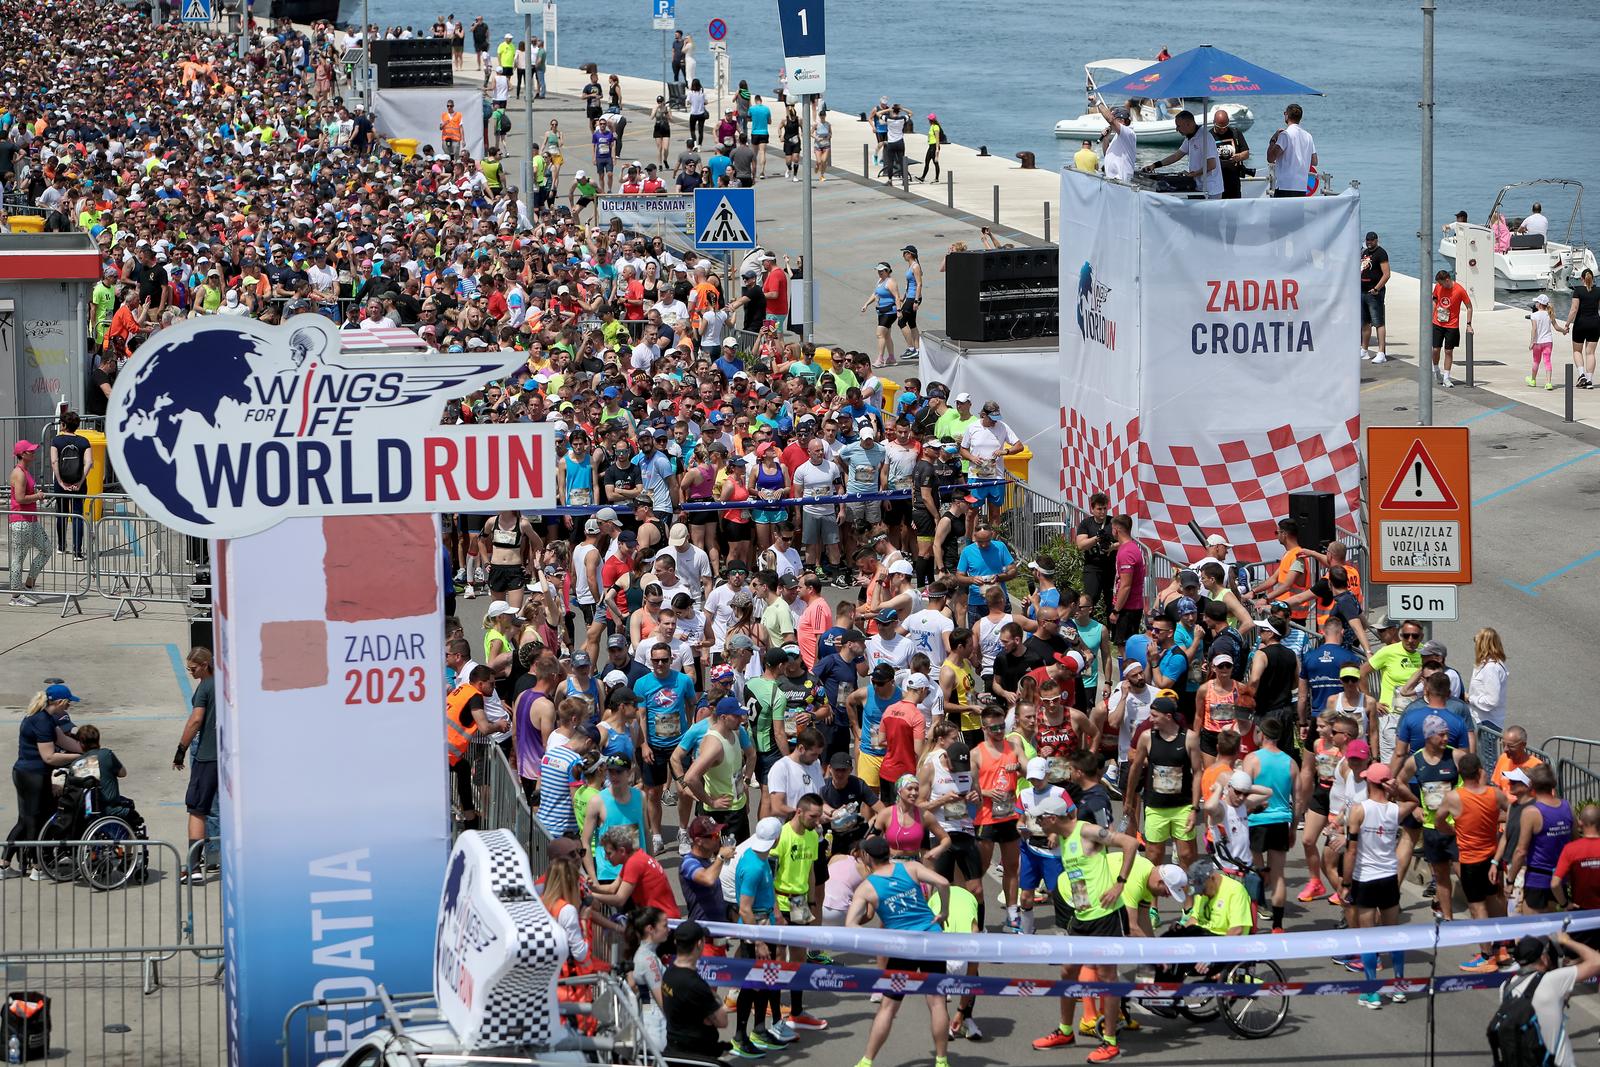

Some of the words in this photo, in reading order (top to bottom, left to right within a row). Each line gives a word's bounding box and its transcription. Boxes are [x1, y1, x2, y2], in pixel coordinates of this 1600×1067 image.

[797, 9, 808, 36] 1
[1209, 84, 1236, 92] Red
[1236, 83, 1262, 92] Bull
[602, 200, 639, 211] UGLJAN
[646, 198, 686, 210] PAŠMAN
[1206, 279, 1299, 313] ZADAR
[1191, 320, 1315, 355] CROATIA
[254, 366, 403, 406] WINGS
[244, 408, 277, 423] FOR
[273, 405, 361, 438] LIFE
[194, 438, 412, 509] WORLD
[423, 434, 543, 502] RUN
[1387, 526, 1453, 538] ULAZ/IZLAZ
[1393, 541, 1430, 552] VOZILA
[1434, 541, 1448, 552] SA
[1390, 553, 1451, 567] GRAIŠTA
[1401, 595, 1424, 611] 50
[1429, 597, 1444, 611] m
[344, 633, 426, 663] ZADAR
[344, 666, 426, 705] 2023
[1041, 734, 1070, 743] KENYA
[309, 847, 377, 1054] ROATIA
[818, 979, 843, 989] WORLD
